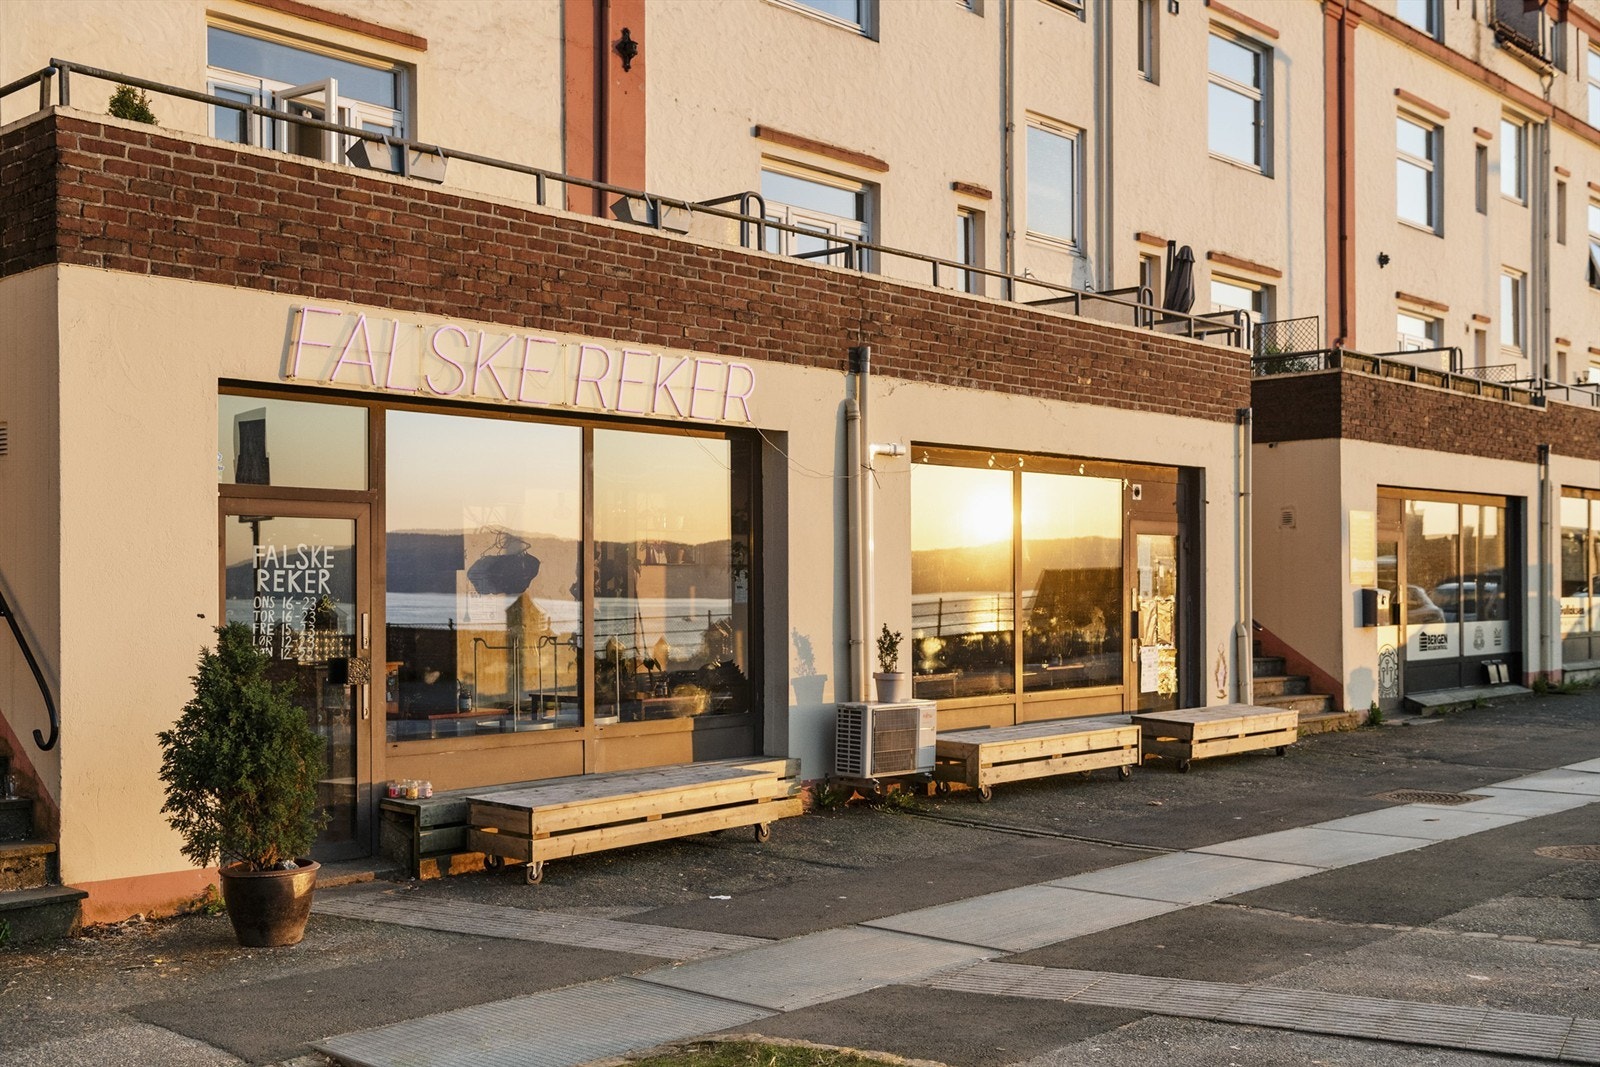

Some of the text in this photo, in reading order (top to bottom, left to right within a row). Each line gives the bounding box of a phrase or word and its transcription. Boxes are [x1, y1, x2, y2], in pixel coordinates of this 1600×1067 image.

[294, 306, 756, 422] FALSKE REKER
[253, 543, 335, 570] FALSKE
[257, 568, 331, 595] REKER
[253, 596, 275, 609] ONS
[253, 610, 275, 623] TOR
[252, 623, 275, 636] FRE
[252, 635, 273, 647] LØR
[1427, 633, 1448, 645] BERGEN
